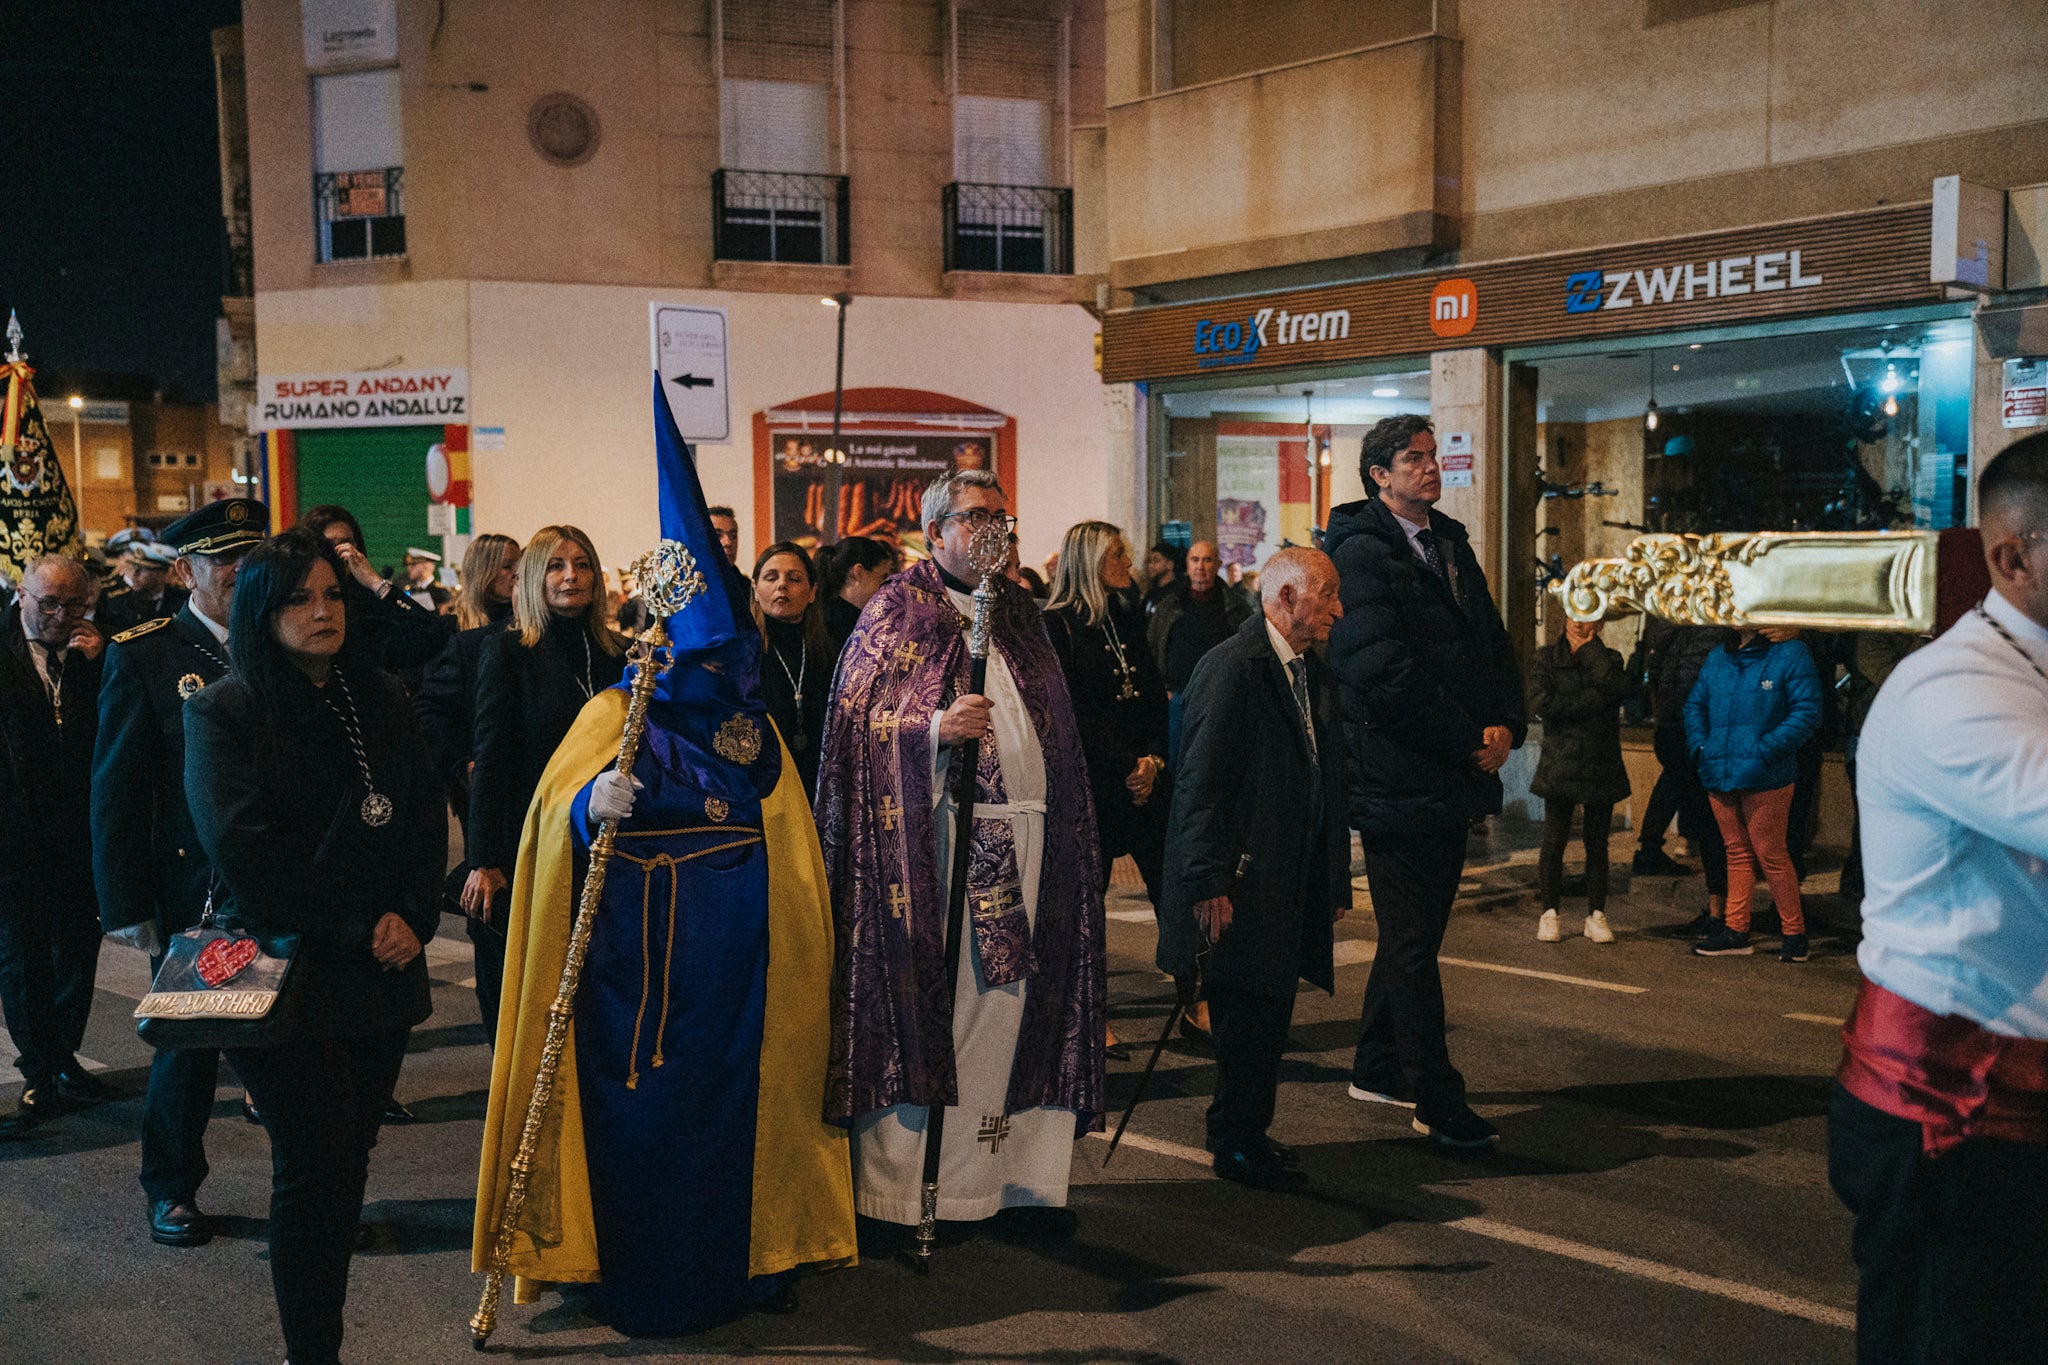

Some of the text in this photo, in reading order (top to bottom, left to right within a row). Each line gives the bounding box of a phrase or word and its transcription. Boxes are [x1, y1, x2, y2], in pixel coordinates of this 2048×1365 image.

[1603, 250, 1823, 310] ZWHEEL
[276, 375, 452, 398] SUPER ANDANY
[2005, 389, 2046, 401] Alarma
[264, 396, 465, 420] RUMANO ANDALUZ
[1443, 456, 1471, 466] Alarma
[136, 992, 274, 1015] LOVE MOSCHINO
